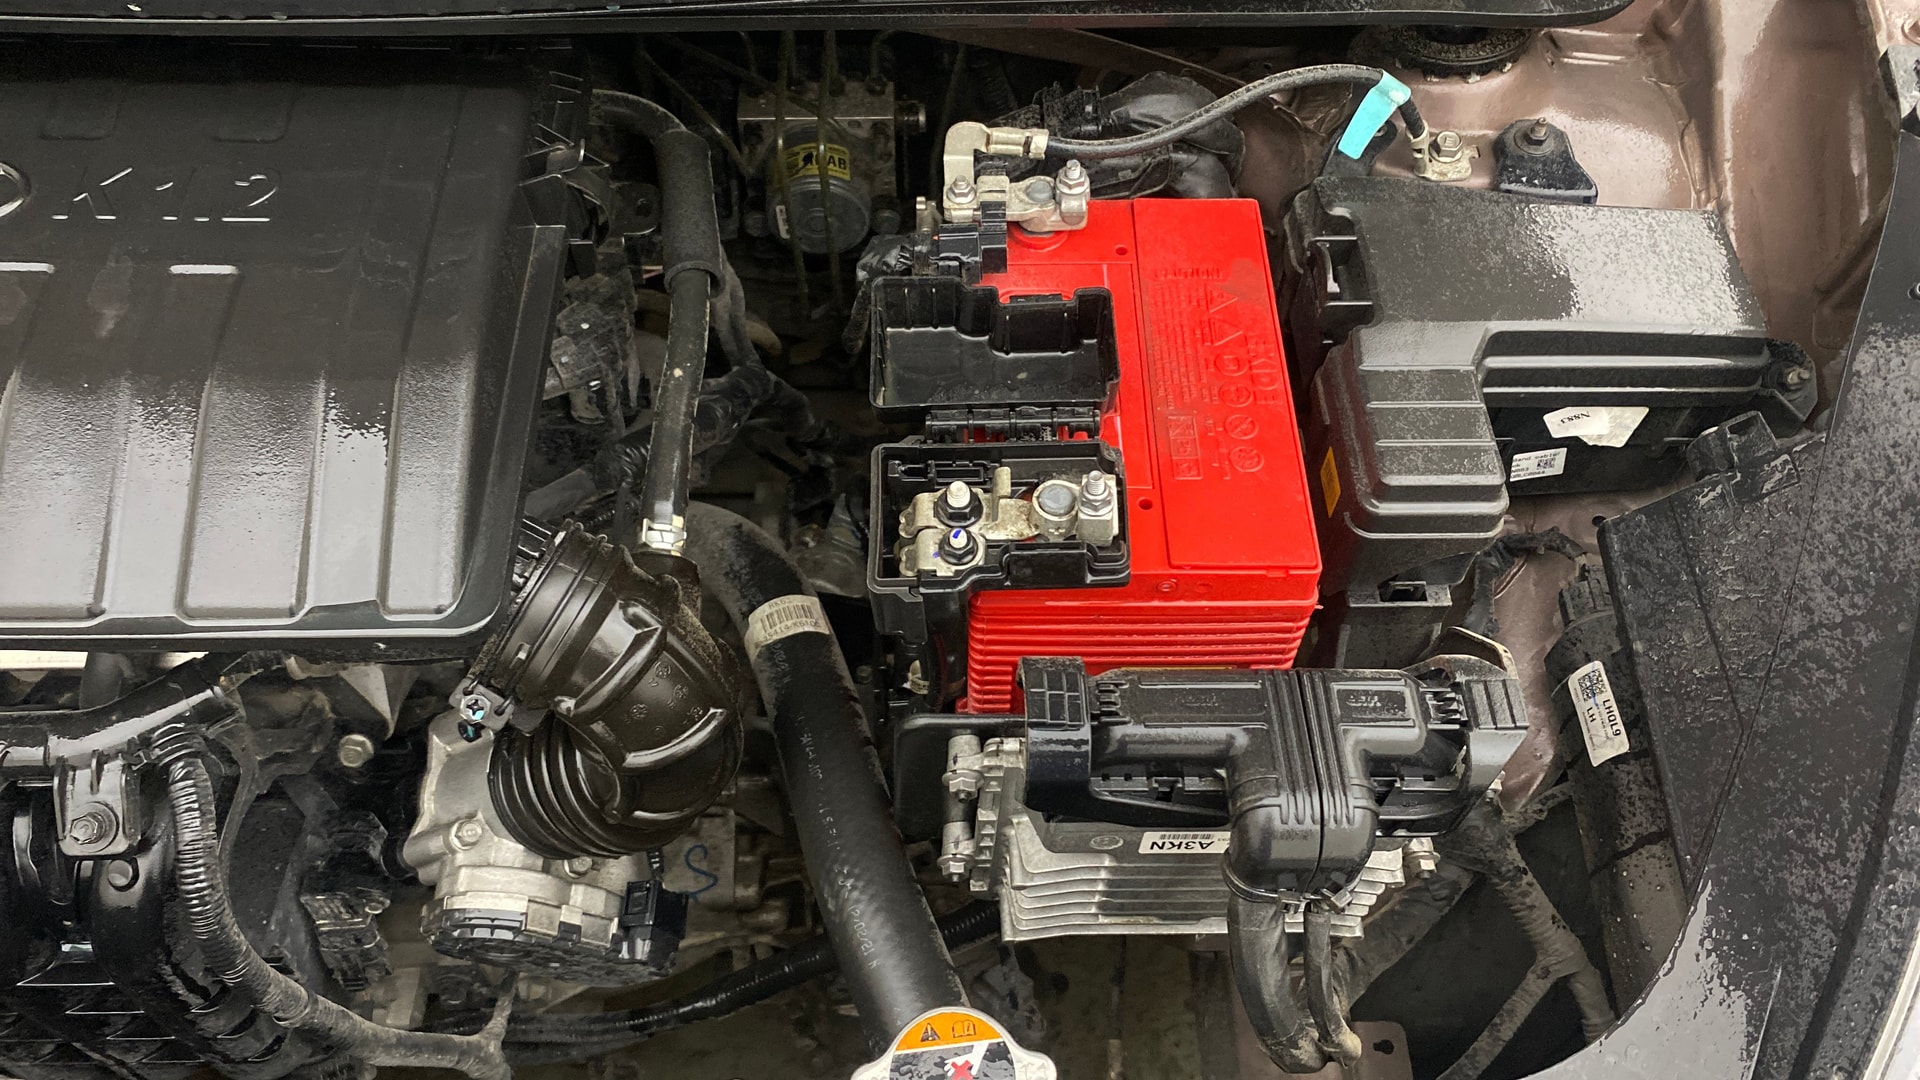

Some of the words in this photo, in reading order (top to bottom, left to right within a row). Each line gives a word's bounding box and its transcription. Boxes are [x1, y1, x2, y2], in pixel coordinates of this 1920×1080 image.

[1560, 411, 1592, 424] N883
[1586, 706, 1596, 723] LH
[1602, 698, 1621, 737] LHQL9
[1149, 840, 1214, 850] A3KN
